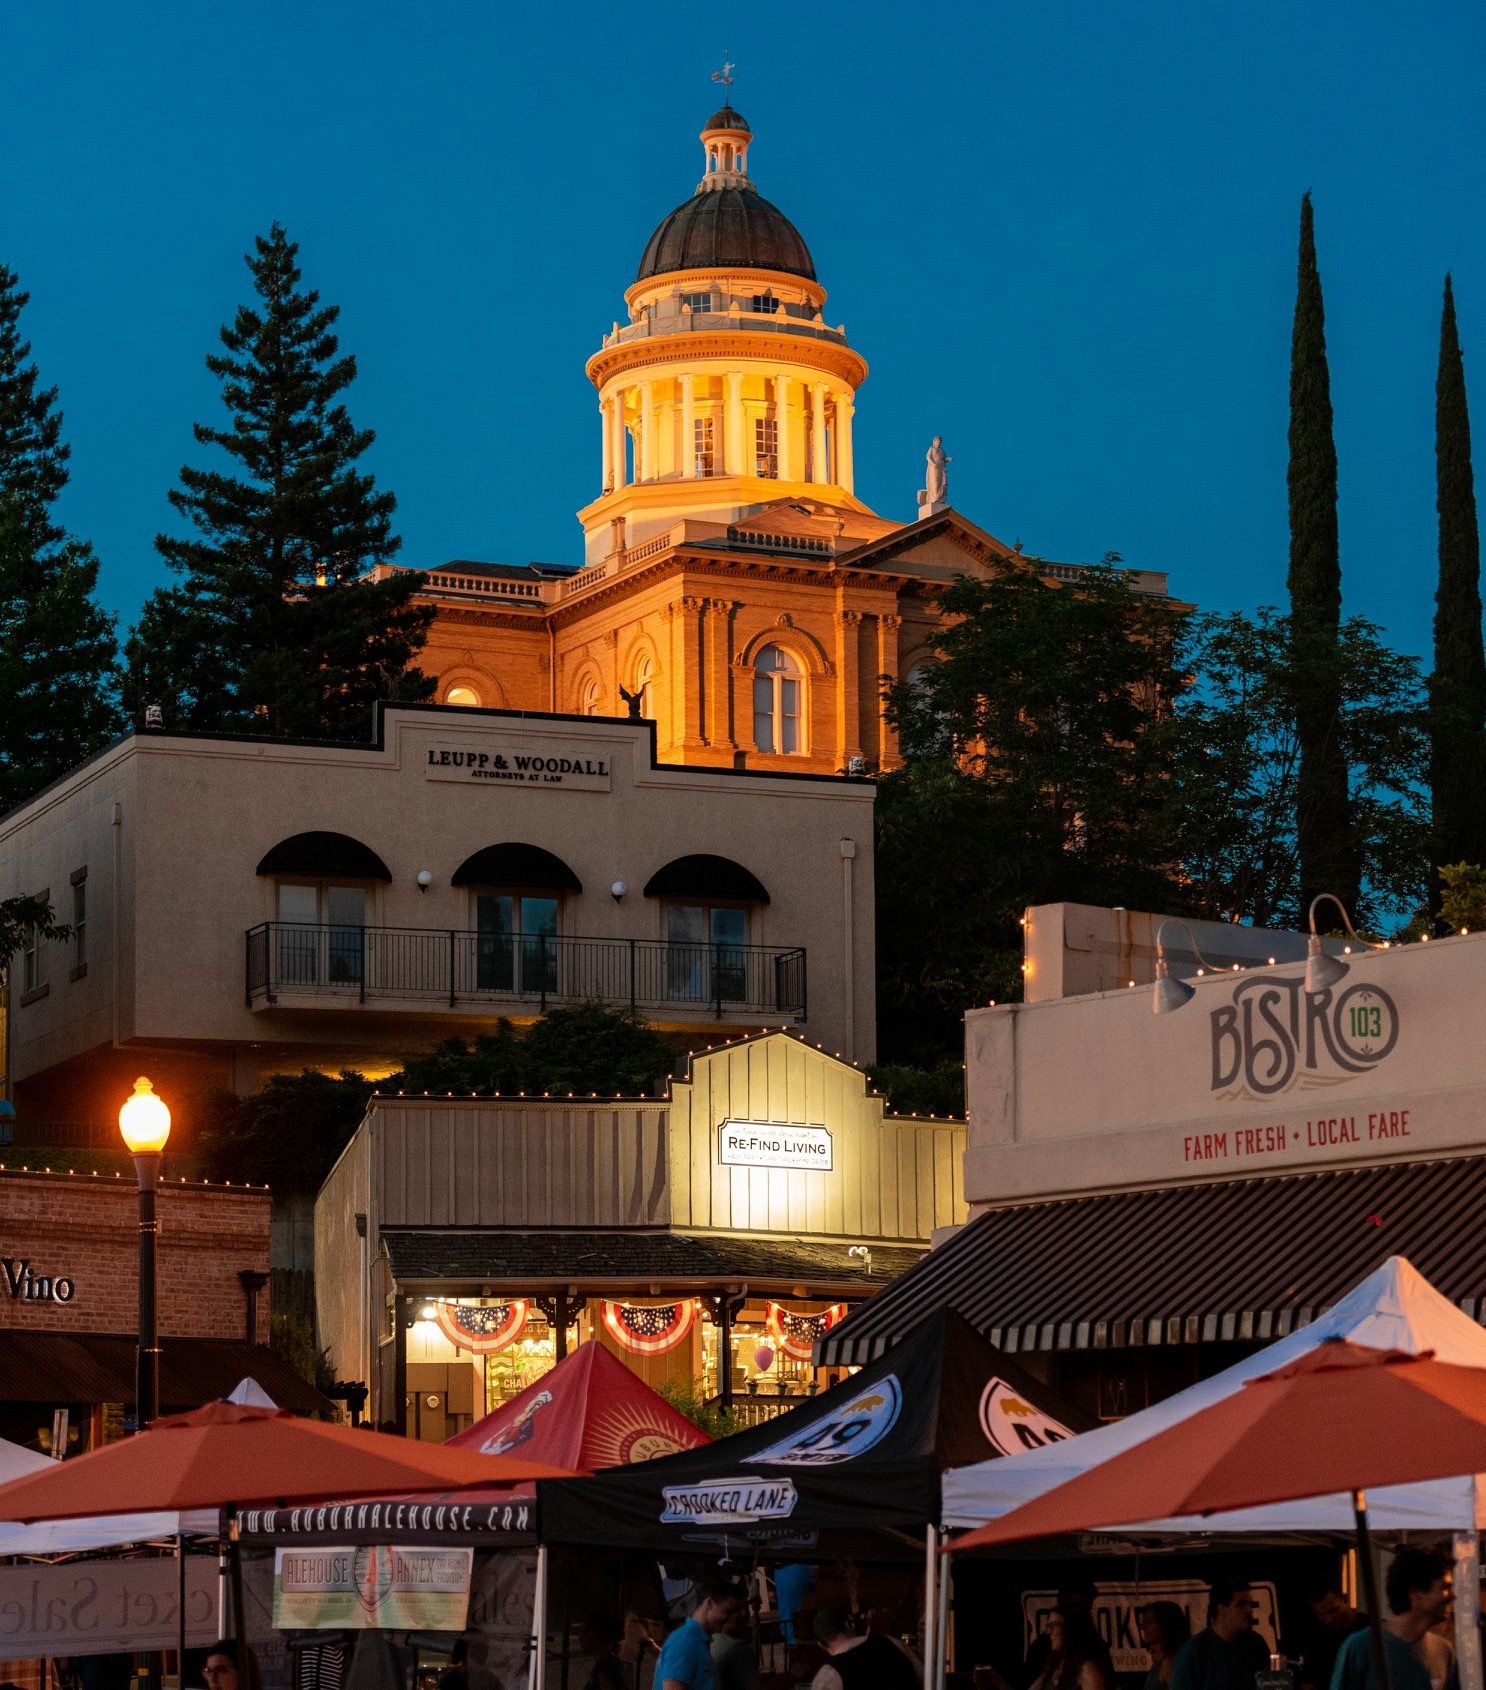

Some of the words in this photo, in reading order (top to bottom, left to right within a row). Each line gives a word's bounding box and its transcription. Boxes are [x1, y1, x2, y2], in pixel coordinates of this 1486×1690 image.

[428, 750, 489, 768] LEUPP
[493, 755, 509, 770] &
[513, 756, 609, 776] WOODALL
[471, 770, 525, 780] ATTORNEYS
[1210, 976, 1399, 1094] BISTRO
[1349, 1006, 1381, 1038] 103
[784, 1140, 826, 1155] LIVING
[1184, 1132, 1227, 1162] FARM
[1235, 1125, 1286, 1157] FRESH
[1307, 1116, 1361, 1147] LOCAL
[1368, 1110, 1411, 1140] FARE
[0, 1257, 75, 1302] Vino
[635, 1439, 673, 1460] UBUR
[670, 1491, 741, 1515] CROOKED
[744, 1487, 789, 1511] LANE
[286, 1558, 349, 1584] ALEHOUSE
[396, 1558, 435, 1583] ANNEX
[1115, 1656, 1149, 1666] WING
